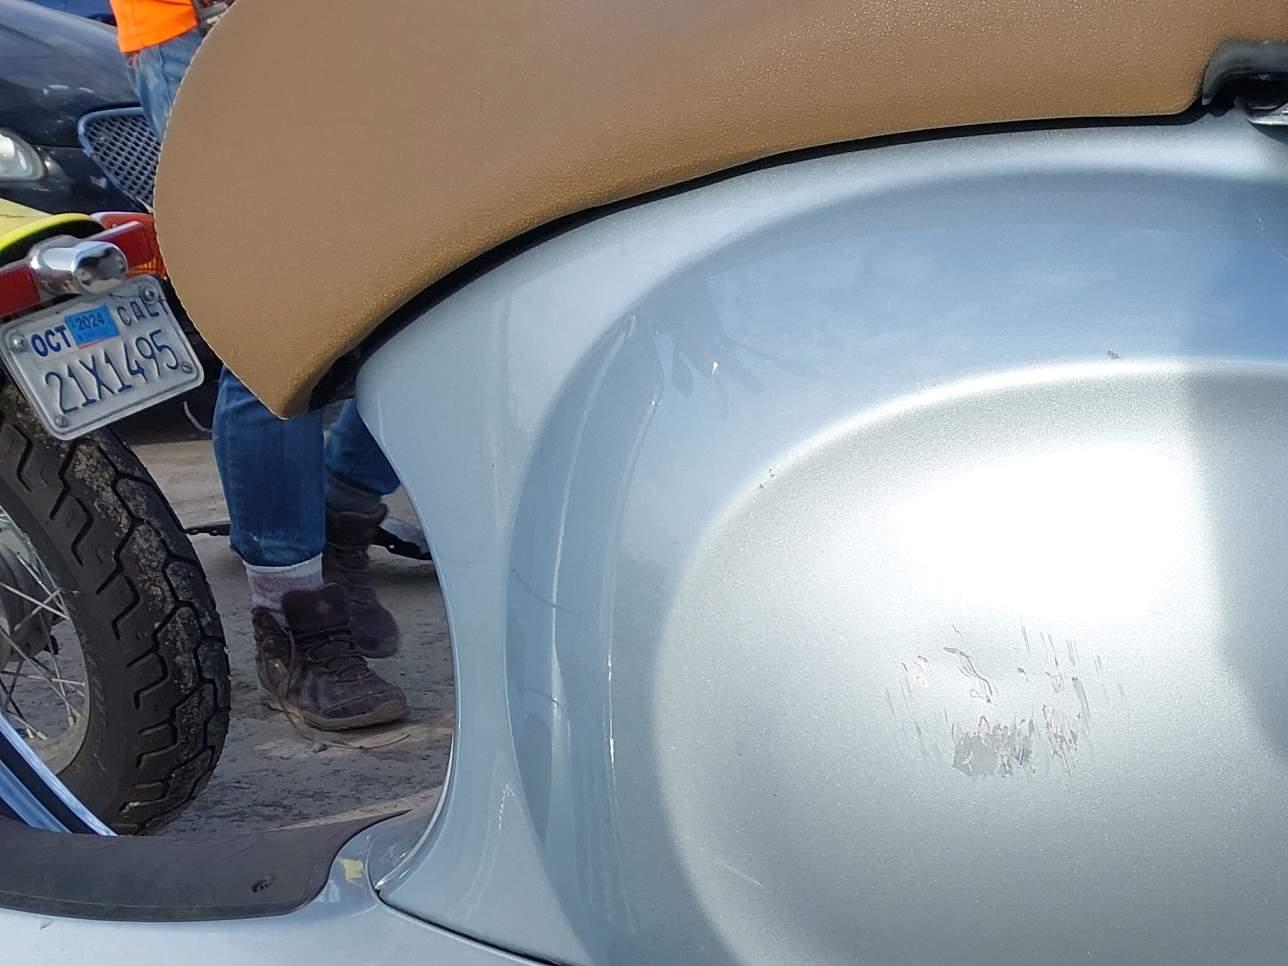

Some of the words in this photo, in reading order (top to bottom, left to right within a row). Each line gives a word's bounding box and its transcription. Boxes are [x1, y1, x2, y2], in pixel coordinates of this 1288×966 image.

[75, 311, 105, 331] 2024
[31, 326, 72, 357] OCT
[45, 329, 179, 414] 21X1495
